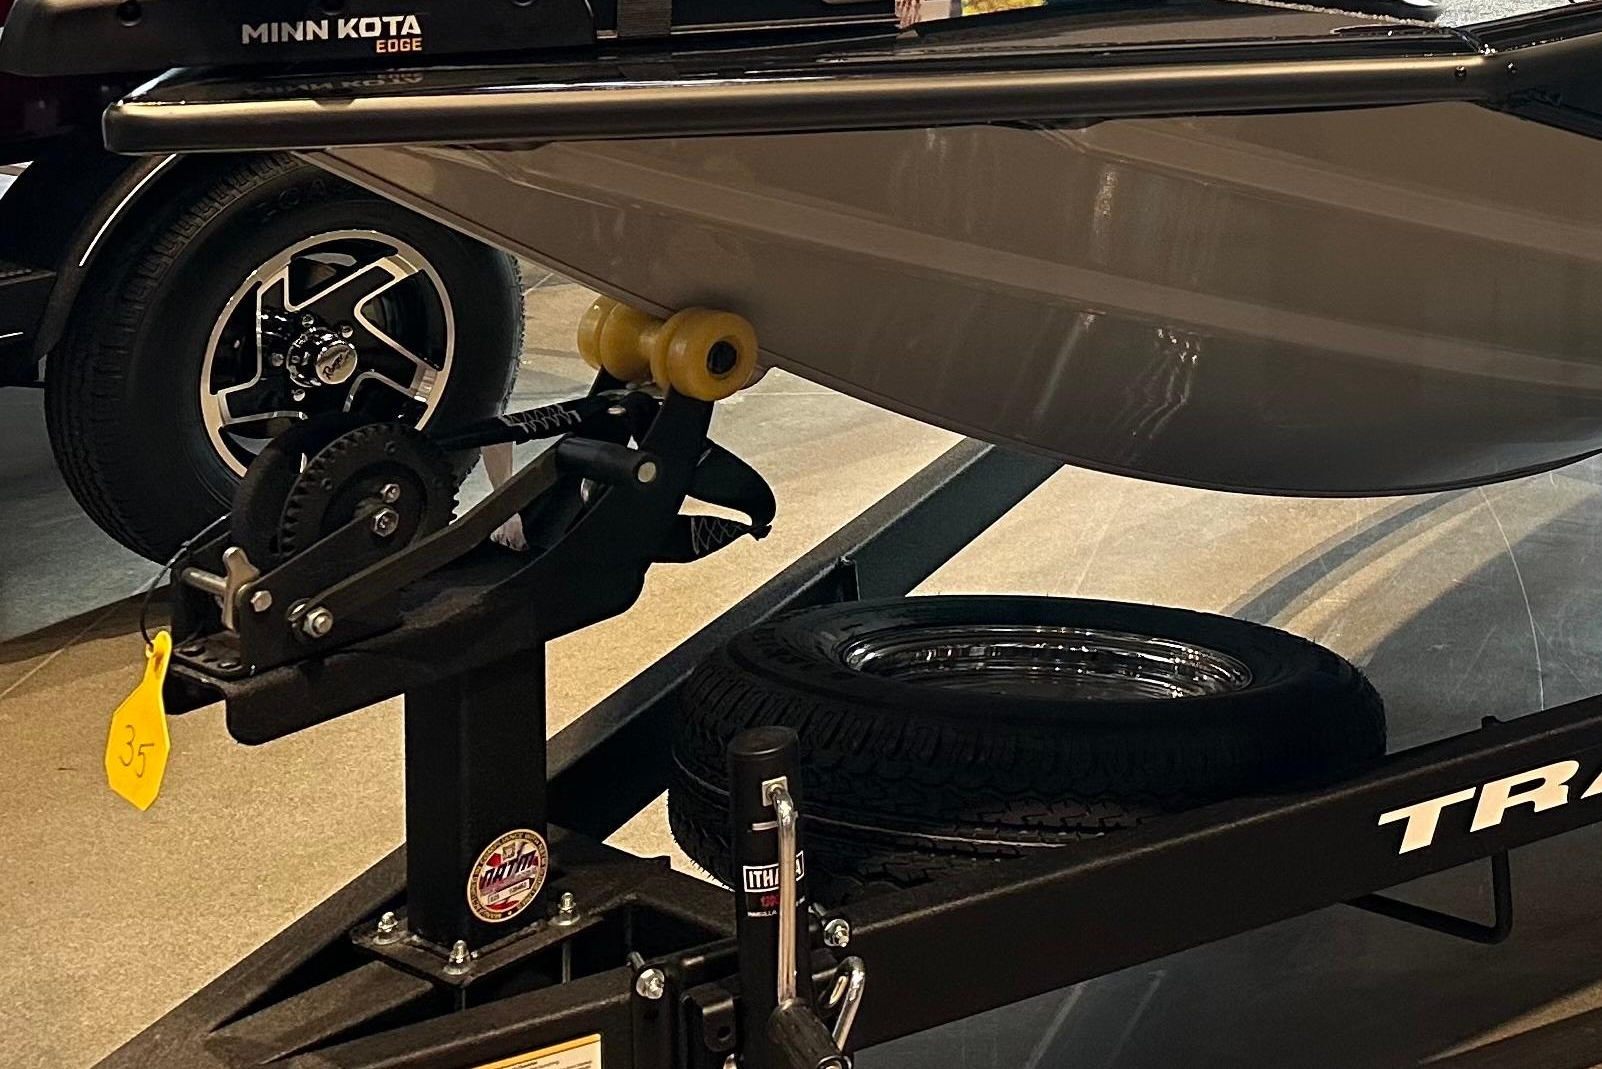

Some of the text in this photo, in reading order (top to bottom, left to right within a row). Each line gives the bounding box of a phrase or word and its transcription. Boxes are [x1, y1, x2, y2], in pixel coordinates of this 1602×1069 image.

[241, 15, 422, 44] MINN KOTA
[376, 37, 422, 53] EDGE
